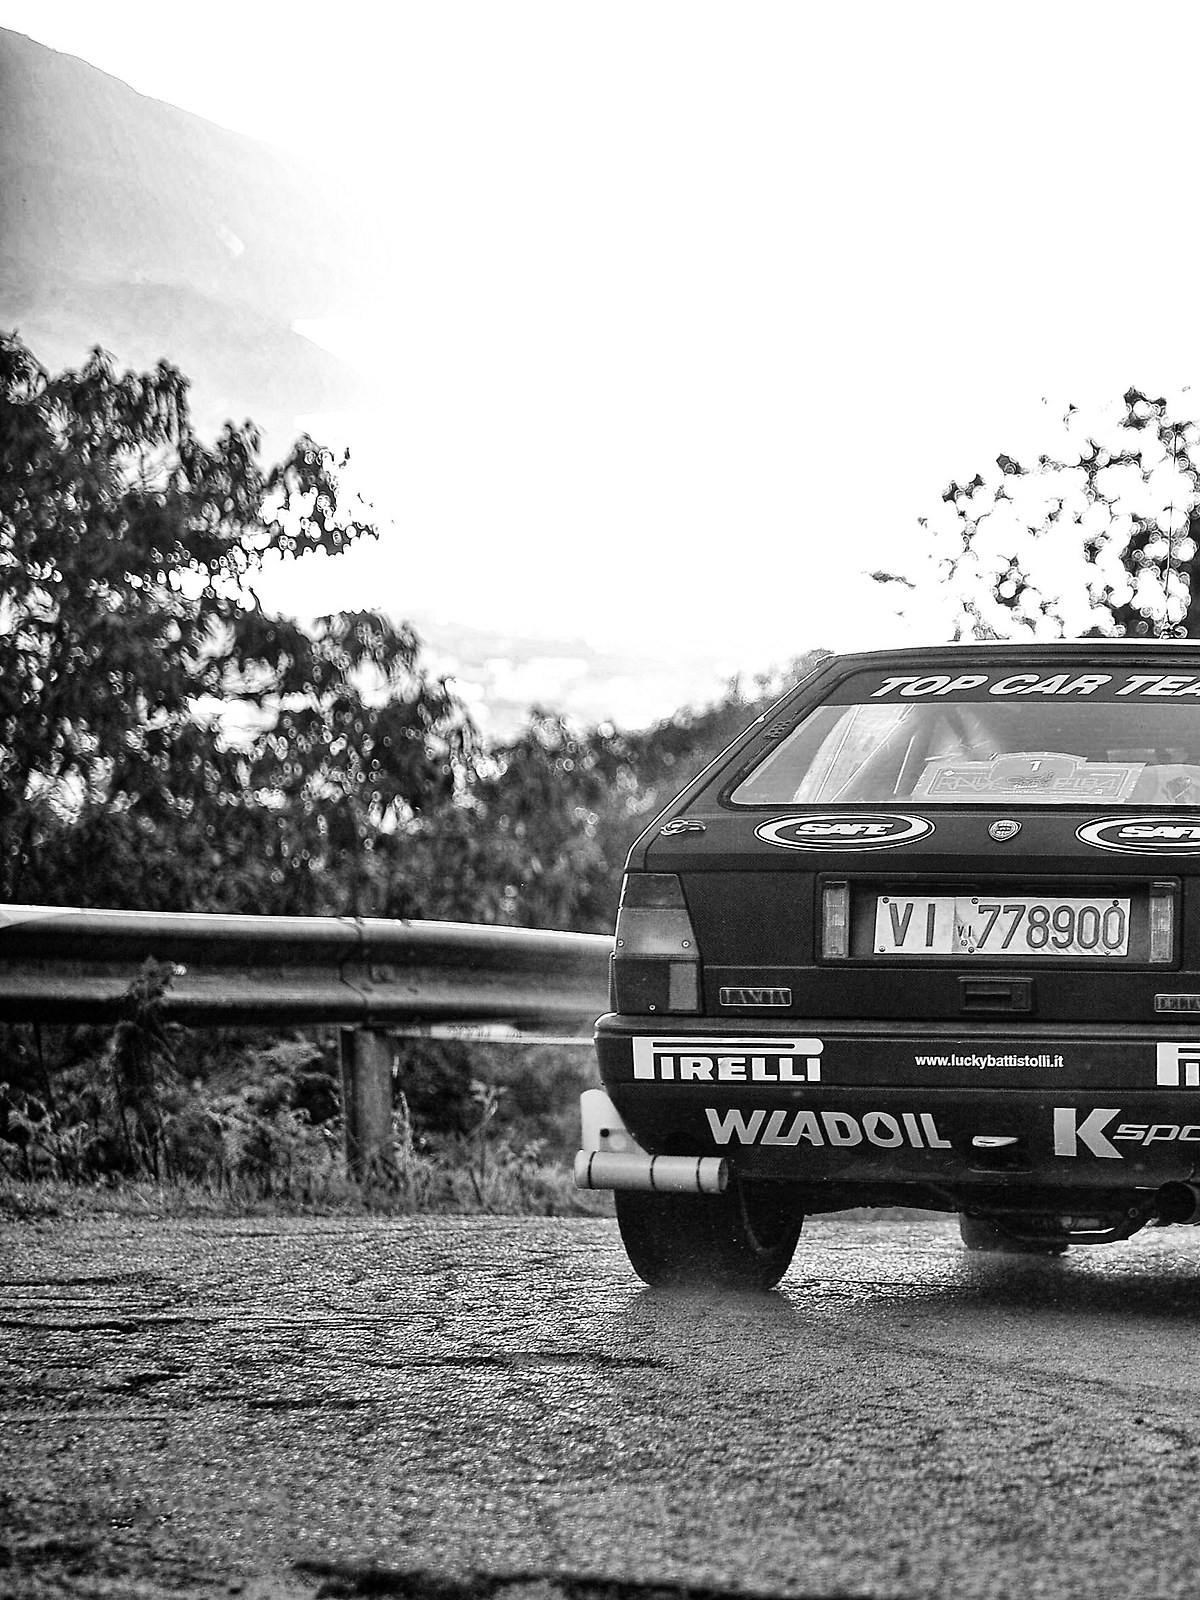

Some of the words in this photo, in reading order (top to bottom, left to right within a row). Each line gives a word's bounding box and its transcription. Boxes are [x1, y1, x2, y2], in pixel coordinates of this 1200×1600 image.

[869, 674, 989, 698] TOP
[987, 674, 1113, 697] CAR
[795, 823, 894, 836] SAFE
[889, 902, 936, 948] VI
[976, 904, 1126, 950] 778900
[632, 1036, 824, 1082] PIRELLI
[914, 1052, 1065, 1070] www.luckybattistolli.it
